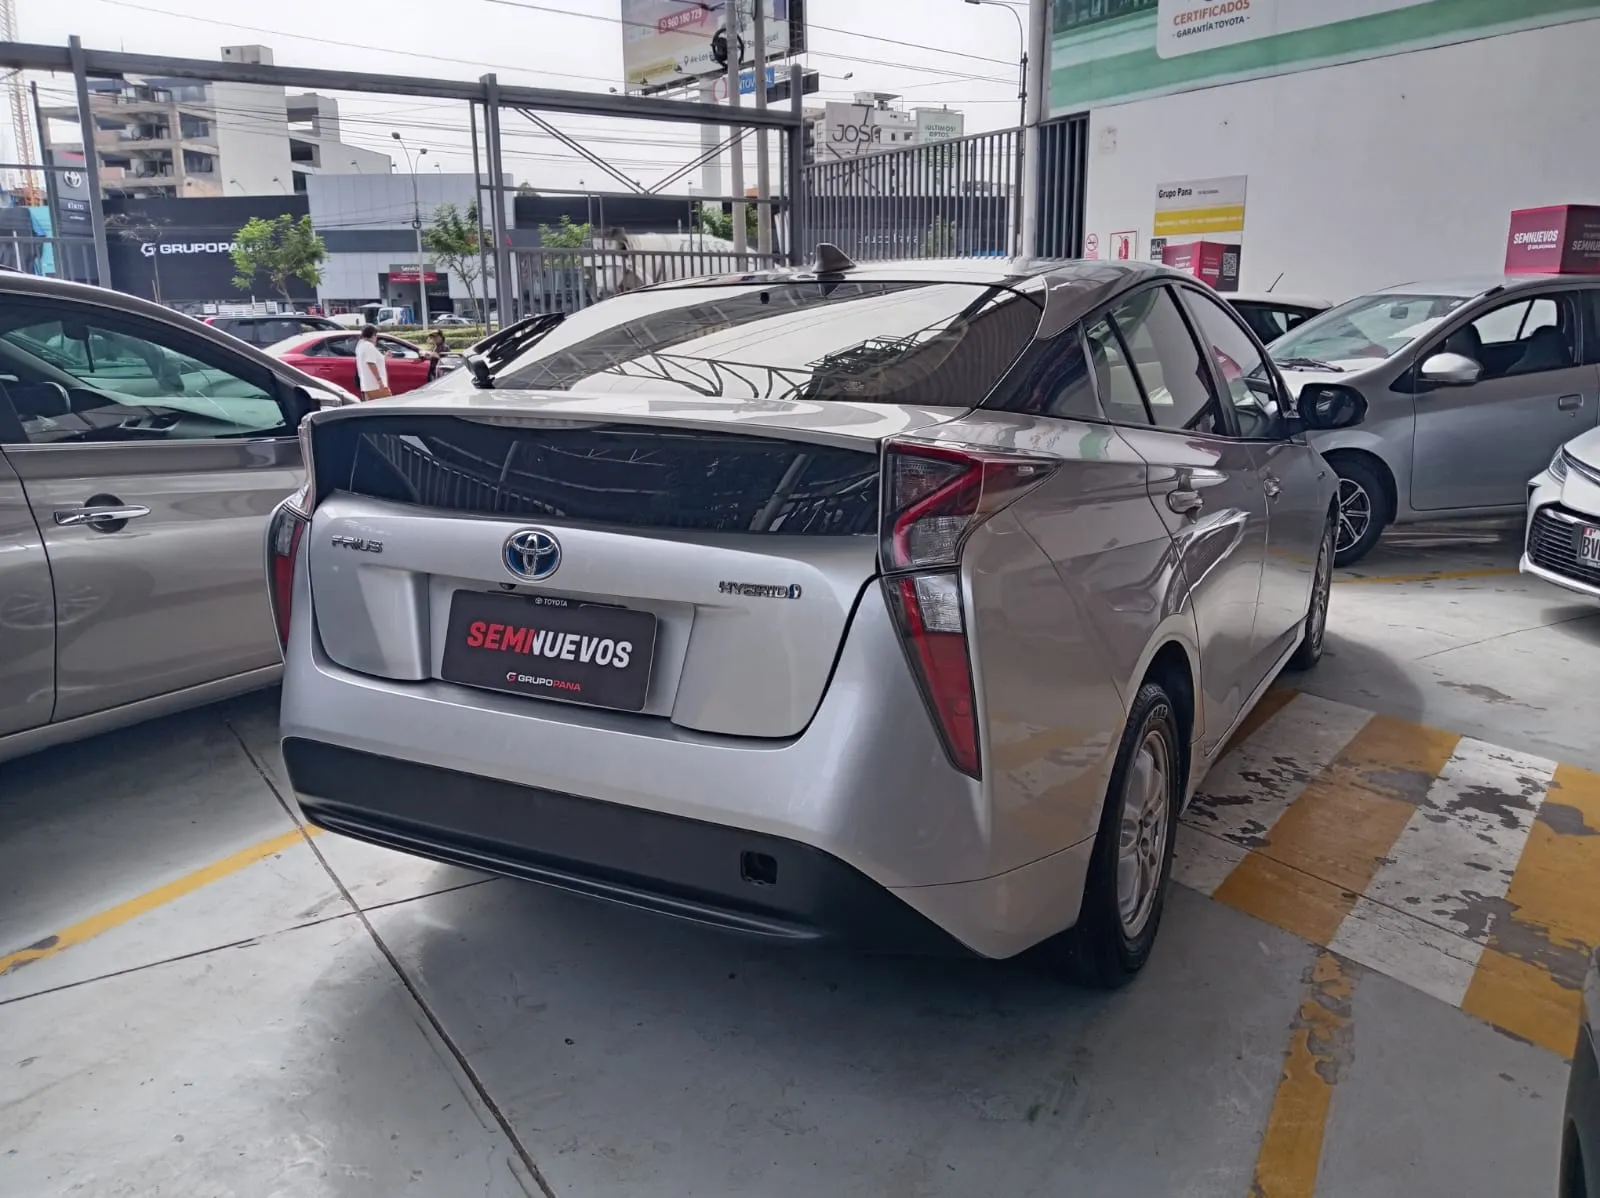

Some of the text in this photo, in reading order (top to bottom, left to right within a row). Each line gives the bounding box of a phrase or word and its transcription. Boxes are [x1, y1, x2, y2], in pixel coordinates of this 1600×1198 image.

[1173, 0, 1250, 26] CERTIFICADOS
[1176, 22, 1213, 38] GARANTÍA
[1215, 15, 1245, 29] TOYOTA
[1159, 189, 1177, 199] Grupo
[1177, 187, 1192, 197] Pana
[331, 534, 384, 554] PRIUS
[718, 581, 788, 599] HYBRID
[543, 598, 568, 607] TOYOTA
[466, 621, 633, 668] SEMINUEVOS
[517, 674, 582, 691] GRUPOPANA
